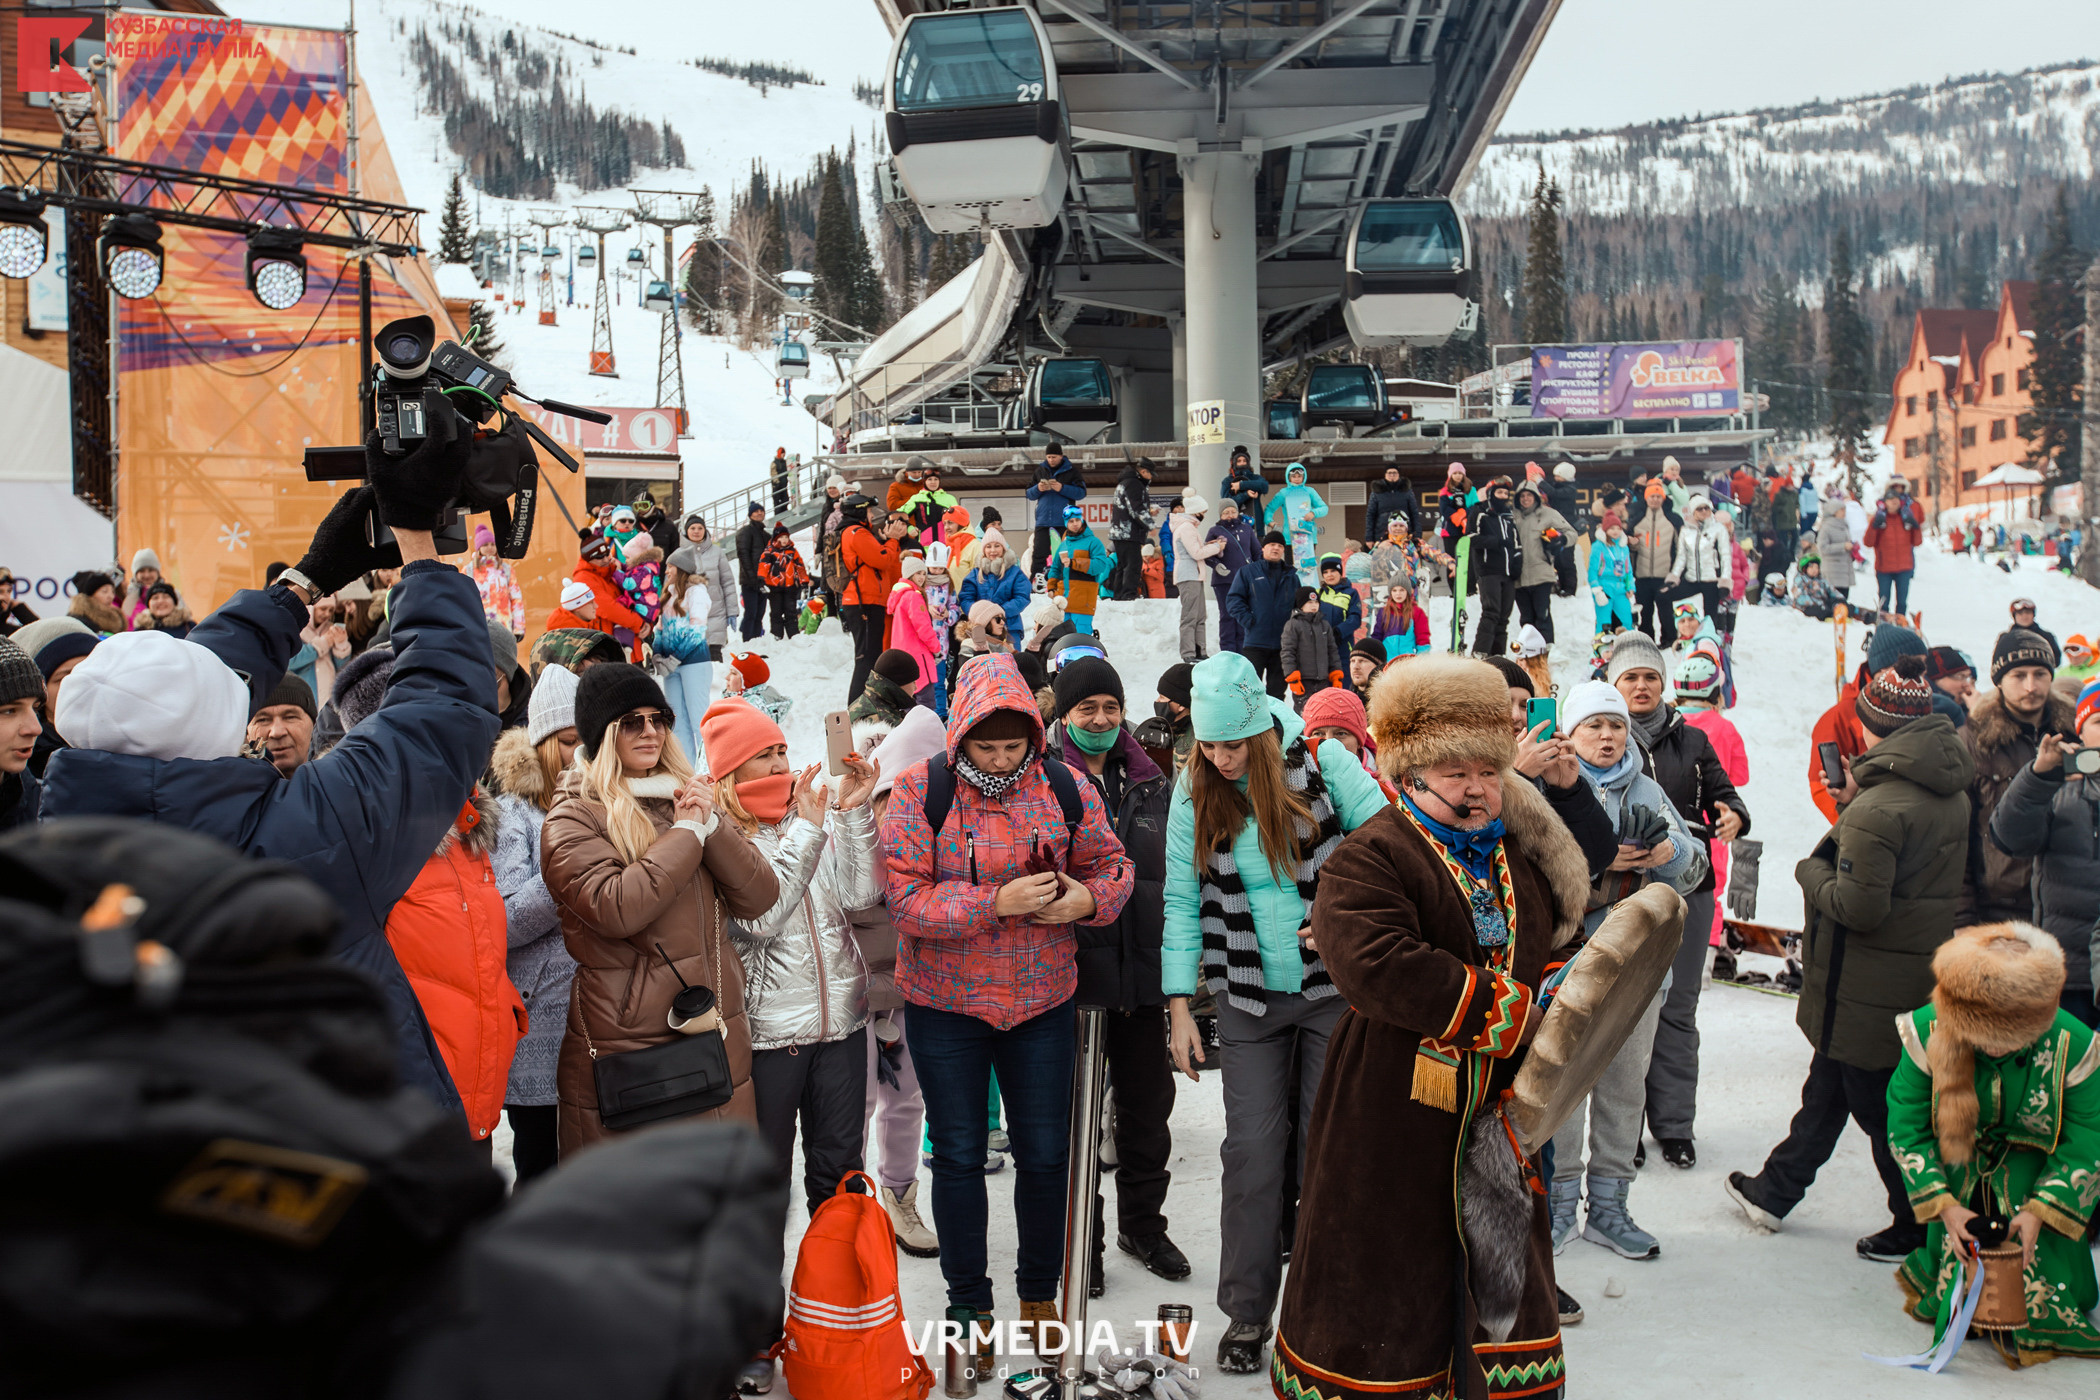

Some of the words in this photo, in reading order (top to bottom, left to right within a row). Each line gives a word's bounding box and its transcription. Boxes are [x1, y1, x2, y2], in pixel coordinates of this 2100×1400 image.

[1016, 82, 1043, 102] 29
[1566, 351, 1600, 360] ПРОКАТ
[1558, 360, 1600, 369] РЕСТОРАН
[1575, 370, 1600, 379] КАФЕ
[1654, 369, 1721, 384] BELKA
[1540, 379, 1600, 388] ИНСТРУКТОРЫ
[1633, 397, 1691, 408] БЕСПЛАТНО
[643, 417, 657, 446] 1
[503, 489, 533, 547] Panasonic
